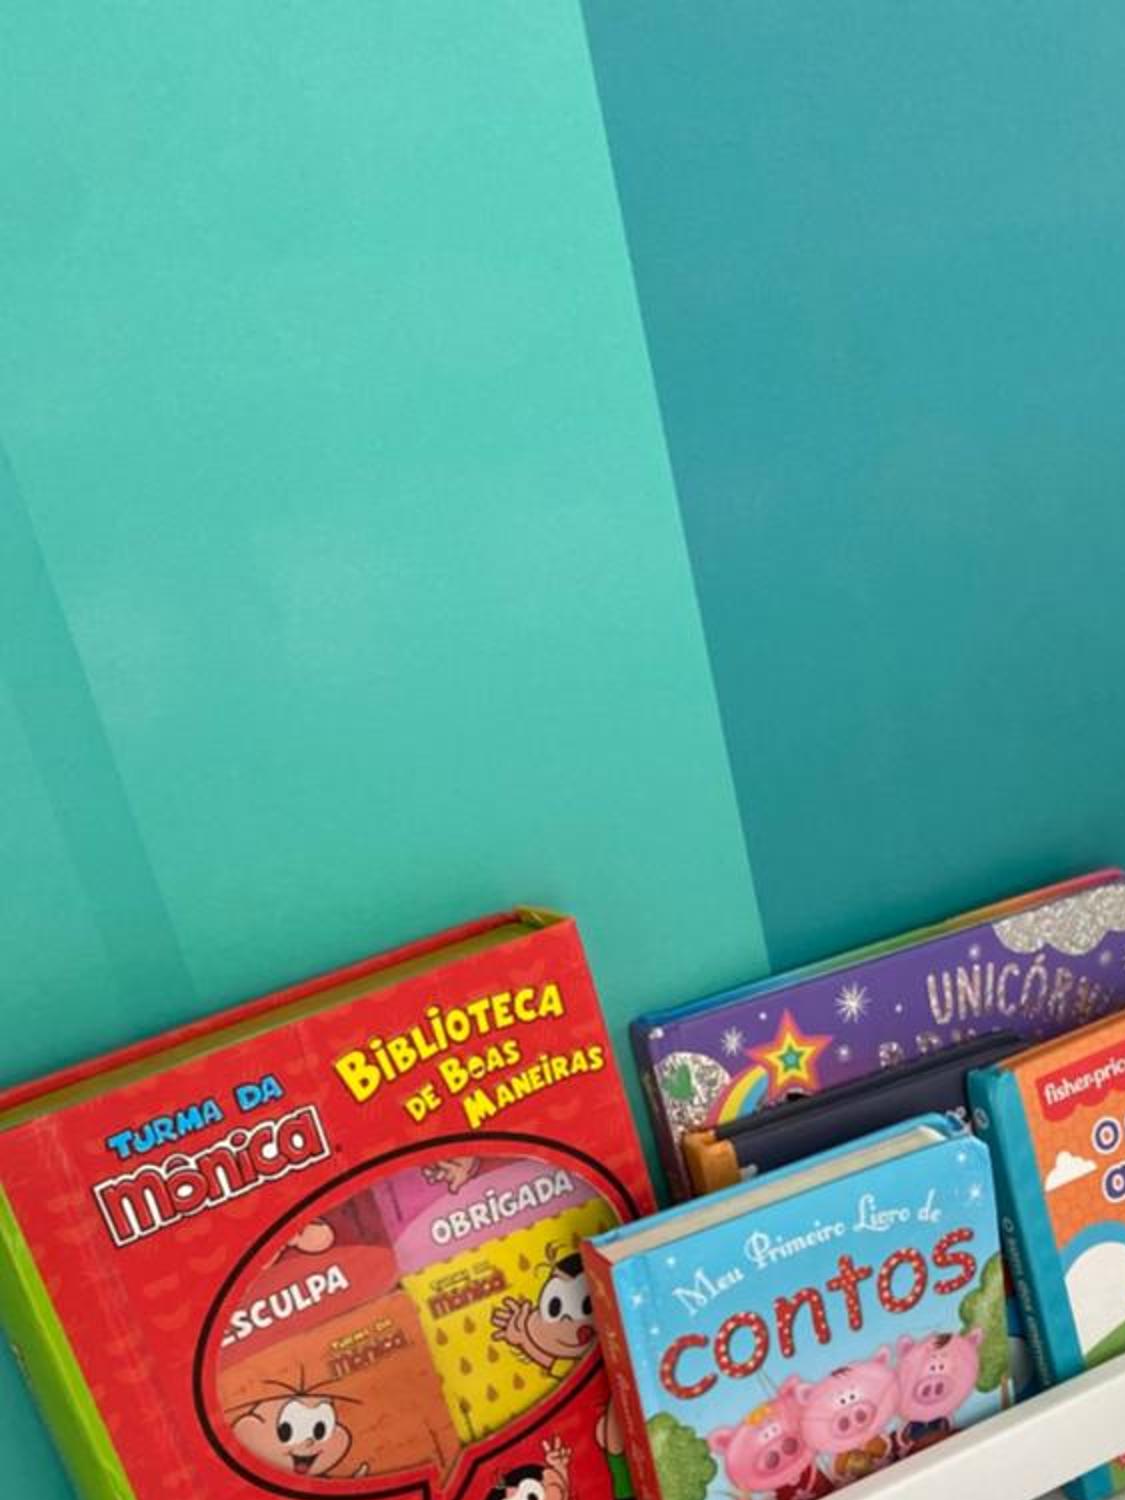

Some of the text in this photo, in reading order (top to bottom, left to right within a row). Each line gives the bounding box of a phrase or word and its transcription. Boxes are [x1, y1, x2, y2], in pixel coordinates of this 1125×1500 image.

[335, 983, 566, 1103] BIBLIOTECA
[404, 1040, 520, 1122] DE BOAS
[107, 1073, 285, 1160] TURMA DA
[462, 1045, 604, 1130] MANEIRAS
[1093, 1117, 1121, 1153] O
[431, 1169, 575, 1245] OBRIGADA
[671, 1188, 943, 1317] Meu Primeiro Livro de
[220, 1264, 350, 1348] SCULPA
[658, 1226, 977, 1400] contos
